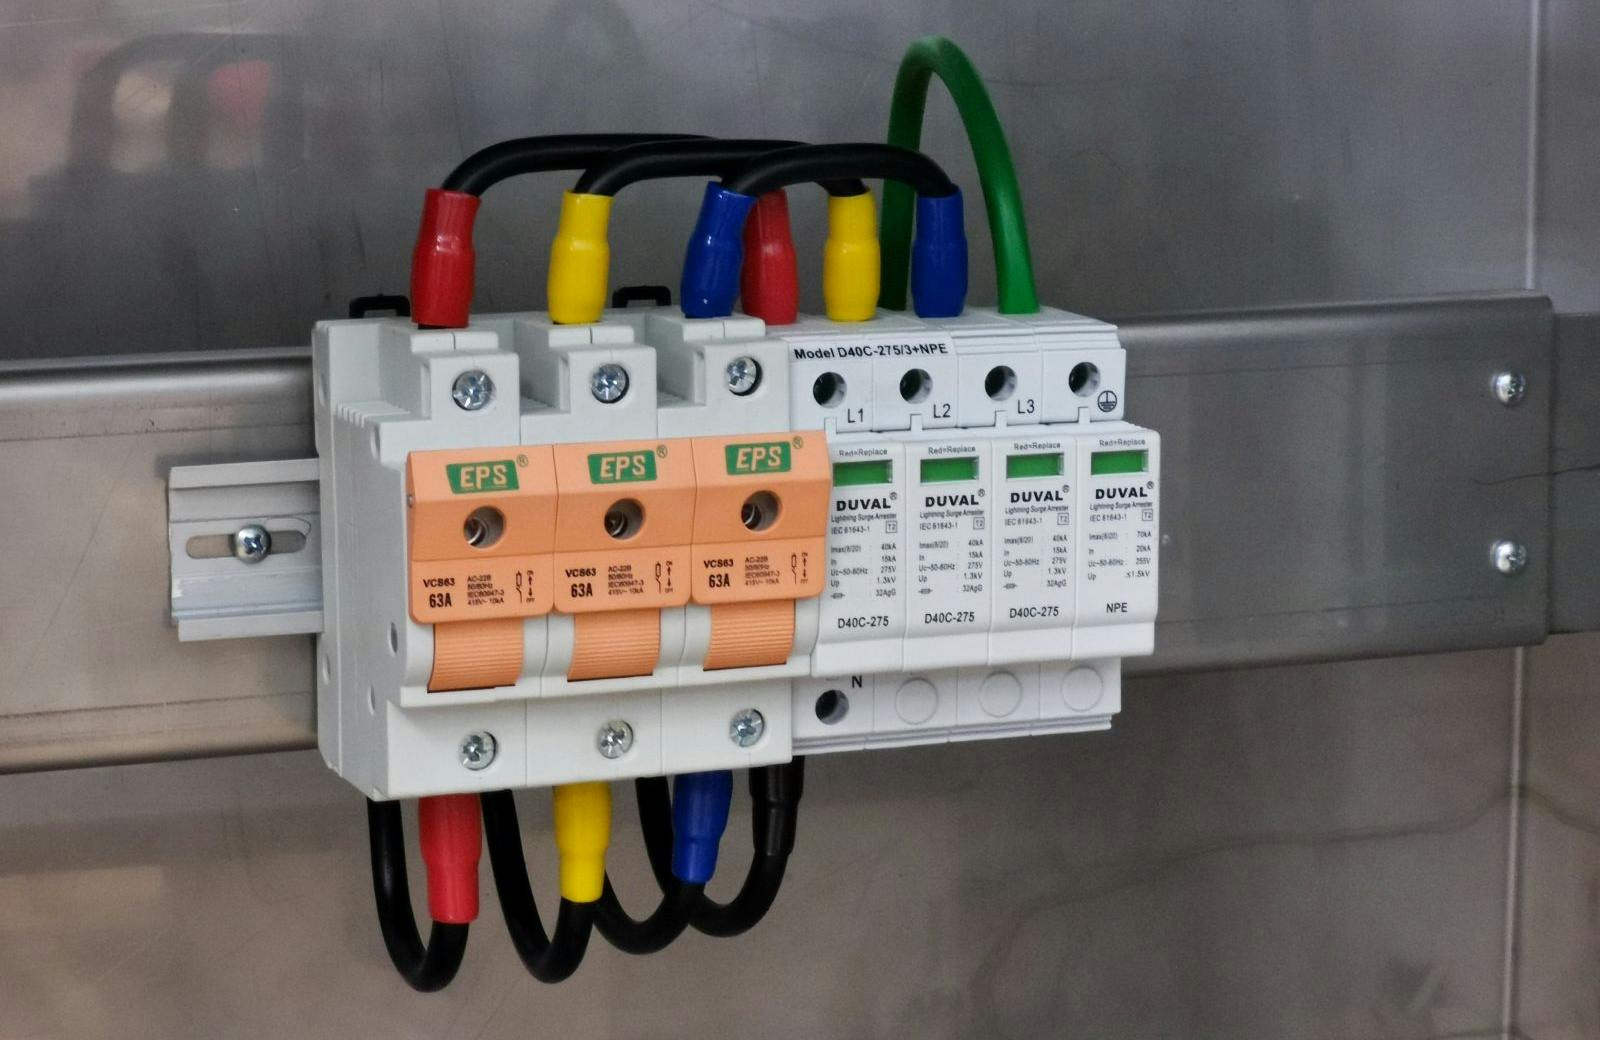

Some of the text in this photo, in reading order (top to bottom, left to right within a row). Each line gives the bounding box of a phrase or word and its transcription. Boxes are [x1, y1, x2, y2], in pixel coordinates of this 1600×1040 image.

[794, 343, 949, 360] Model D40C-275/3+NPE
[933, 403, 951, 418] L2
[1018, 399, 1035, 414] L3
[847, 408, 864, 423] L1
[736, 446, 782, 471] EPS
[600, 454, 646, 480] EPS
[461, 464, 508, 489] EPS
[1010, 490, 1064, 503] DUVAL
[1095, 486, 1148, 499] DUVAL
[836, 498, 891, 511] DUVAL
[925, 494, 979, 507] DUVAL
[1004, 518, 1016, 526] IEC
[1089, 514, 1101, 522] IEC
[831, 527, 843, 535] IEC
[919, 522, 931, 530] IEC
[704, 558, 734, 569] VCS63
[565, 568, 596, 578] VCS63
[423, 577, 455, 588] VCS63
[709, 573, 731, 588] 63A
[571, 582, 593, 598] 63A
[429, 592, 452, 608] 63A
[1009, 606, 1059, 619] D40C-275
[1106, 602, 1128, 613] NPE
[837, 615, 889, 629] D40C-275
[924, 611, 975, 624] D40C-275
[852, 675, 862, 688] N
